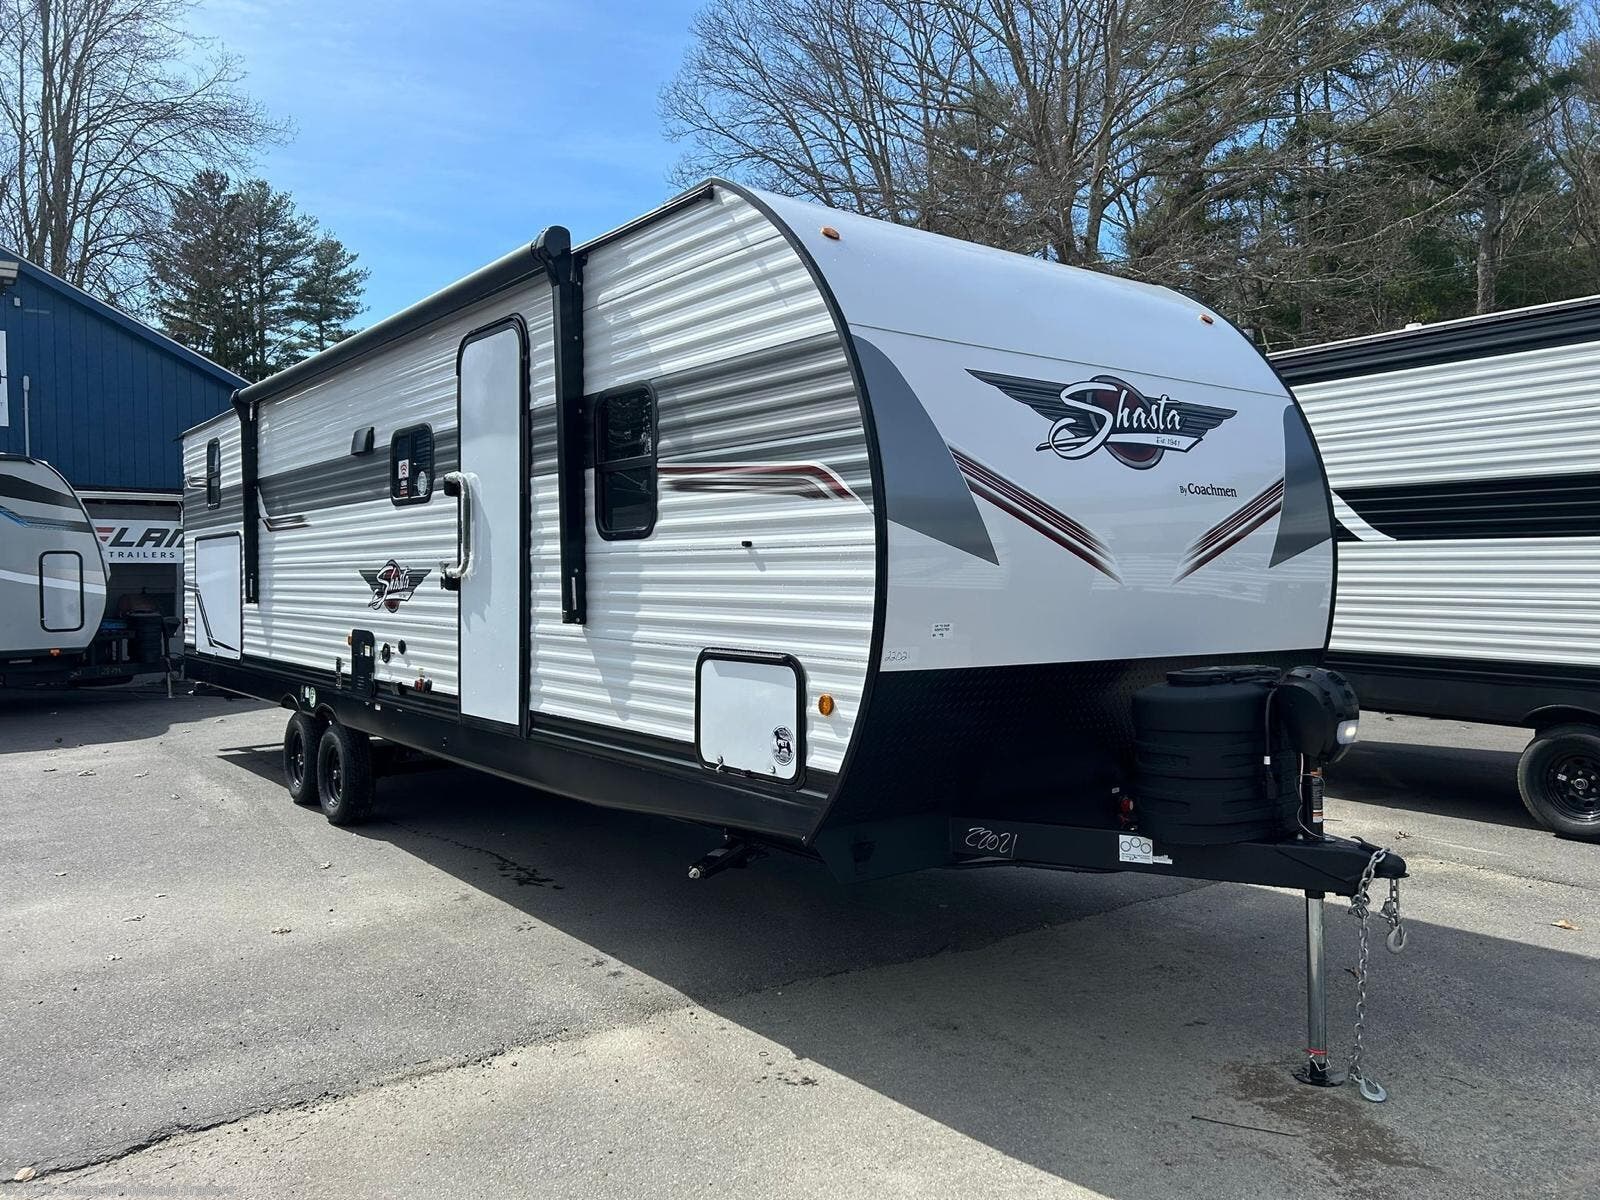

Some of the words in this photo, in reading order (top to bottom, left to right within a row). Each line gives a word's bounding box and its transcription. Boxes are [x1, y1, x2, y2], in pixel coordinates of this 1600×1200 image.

[1046, 380, 1183, 460] Shasta
[1179, 485, 1187, 497] By
[1187, 482, 1238, 498] Coachmen
[108, 551, 176, 559] TRAILERS
[371, 564, 410, 610] Shasta
[965, 826, 1018, 858] 22021
